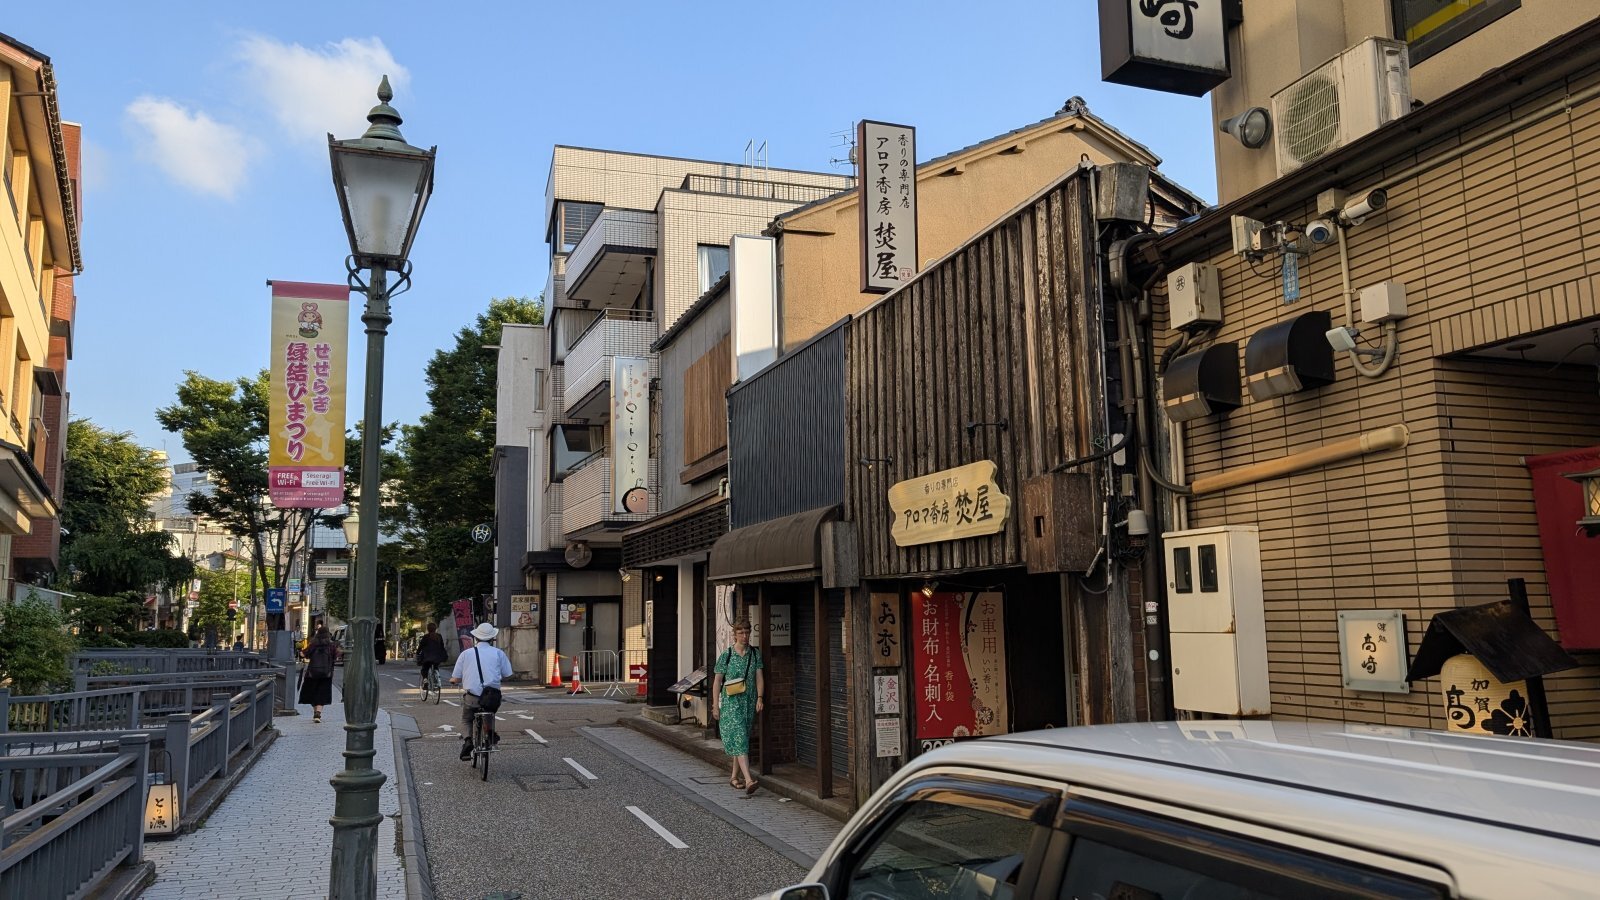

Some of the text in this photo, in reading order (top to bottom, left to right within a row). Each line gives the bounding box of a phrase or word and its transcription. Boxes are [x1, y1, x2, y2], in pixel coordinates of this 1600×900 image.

[897, 133, 911, 209] 香りの専門店
[286, 342, 309, 461] 縁結びまつり
[313, 343, 331, 414] せせらぎ
[924, 476, 959, 495] 香りの専門店
[877, 601, 898, 657] お香
[980, 600, 997, 654] お車用
[922, 600, 943, 722] お財布・名刺入
[944, 671, 955, 702] 香り袋
[886, 677, 898, 711] 金沢の
[1470, 678, 1490, 714] 加賀
